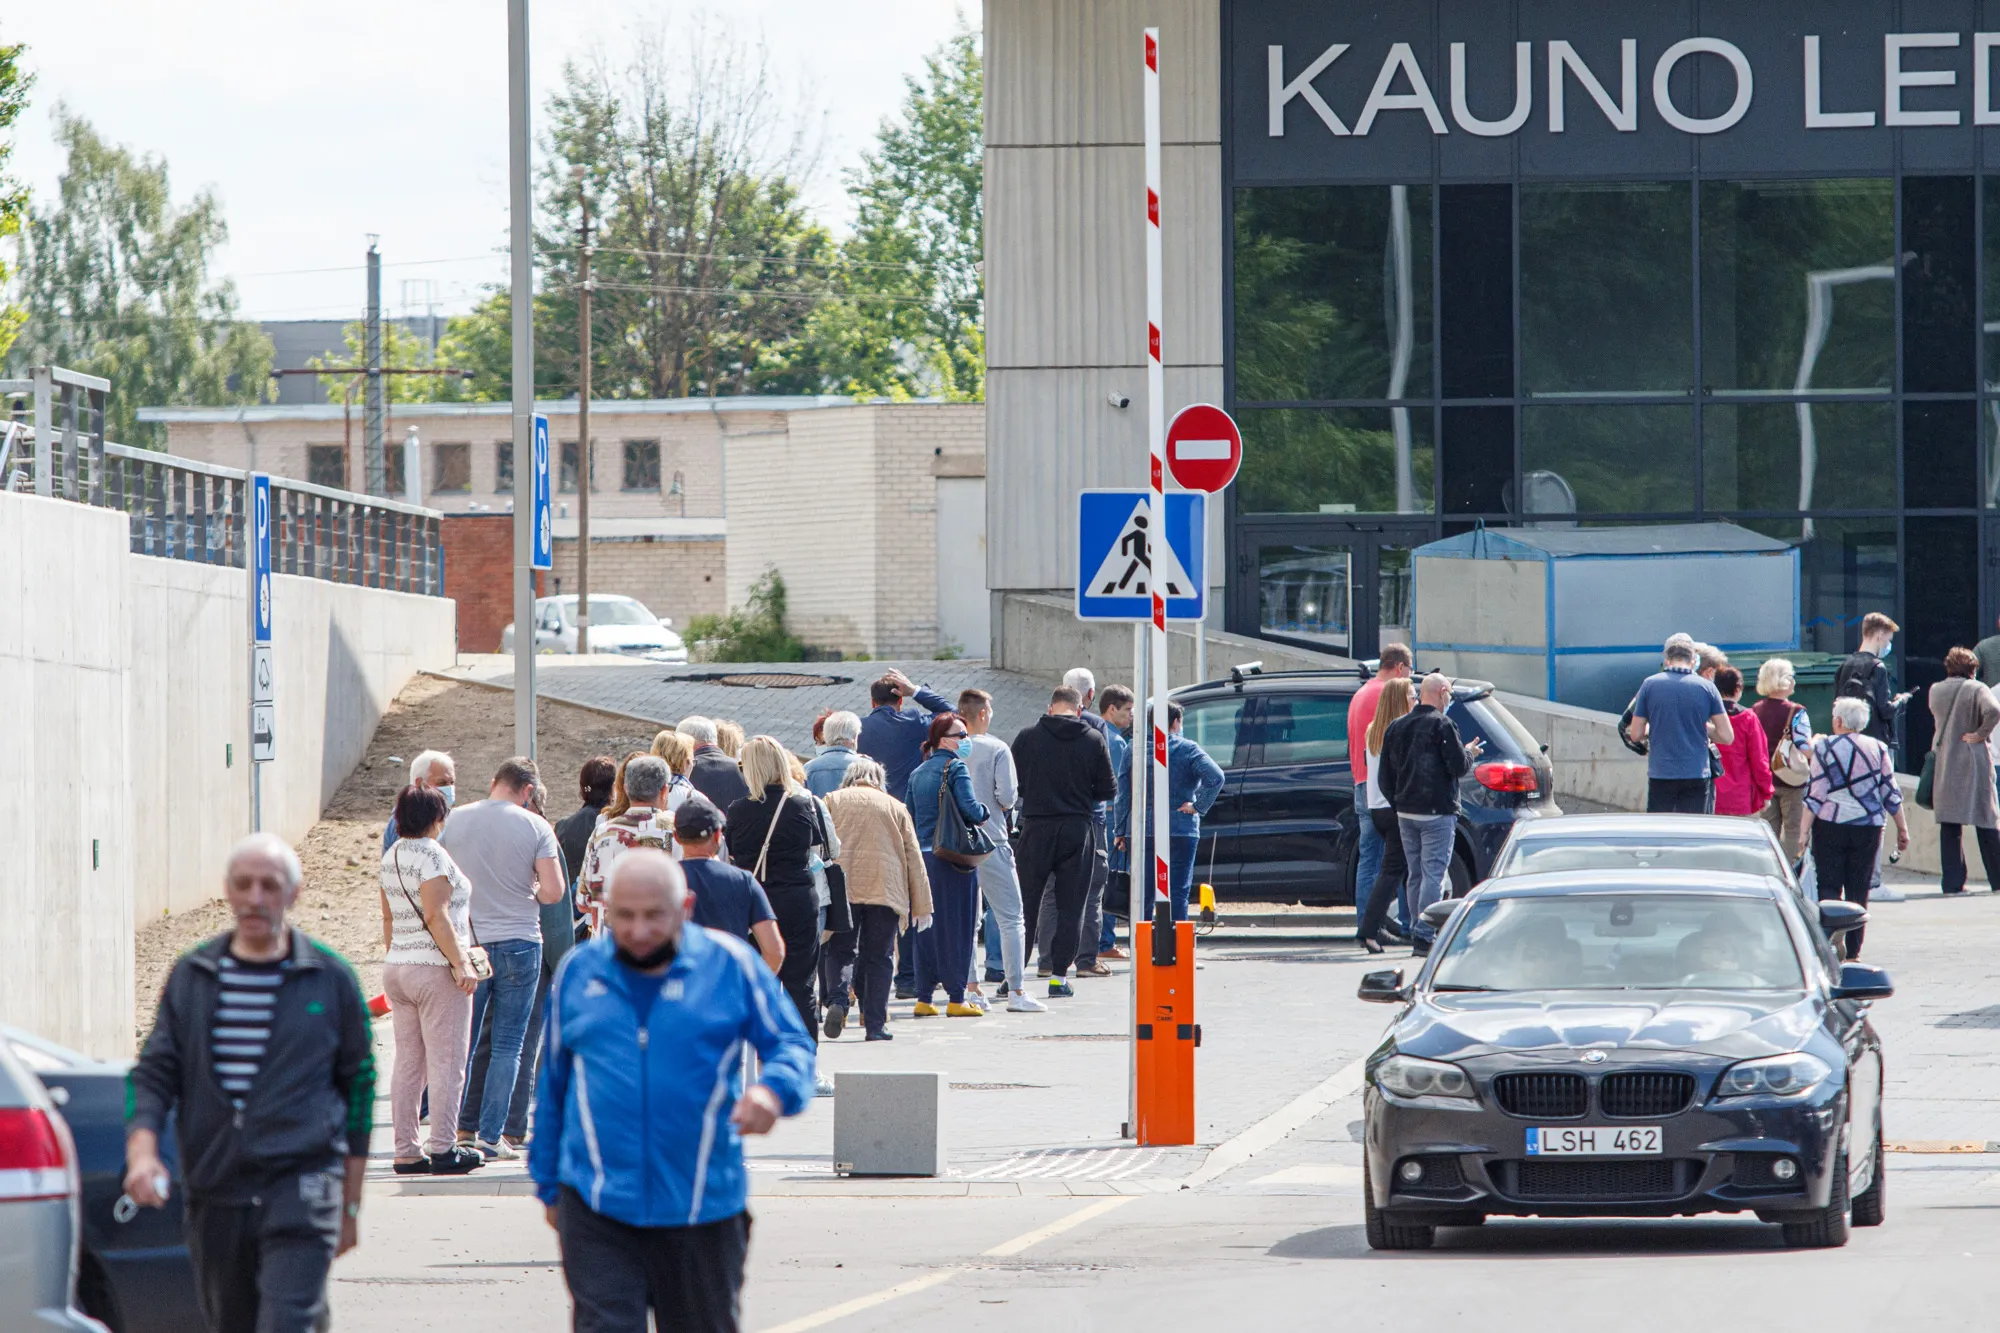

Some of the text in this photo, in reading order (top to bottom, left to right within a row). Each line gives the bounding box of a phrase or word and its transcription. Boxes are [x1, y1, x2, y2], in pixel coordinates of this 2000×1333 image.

[1268, 37, 1754, 137] KAUNO
[538, 427, 547, 500] P
[257, 486, 268, 568] P
[1543, 1130, 1657, 1151] LSH 462
